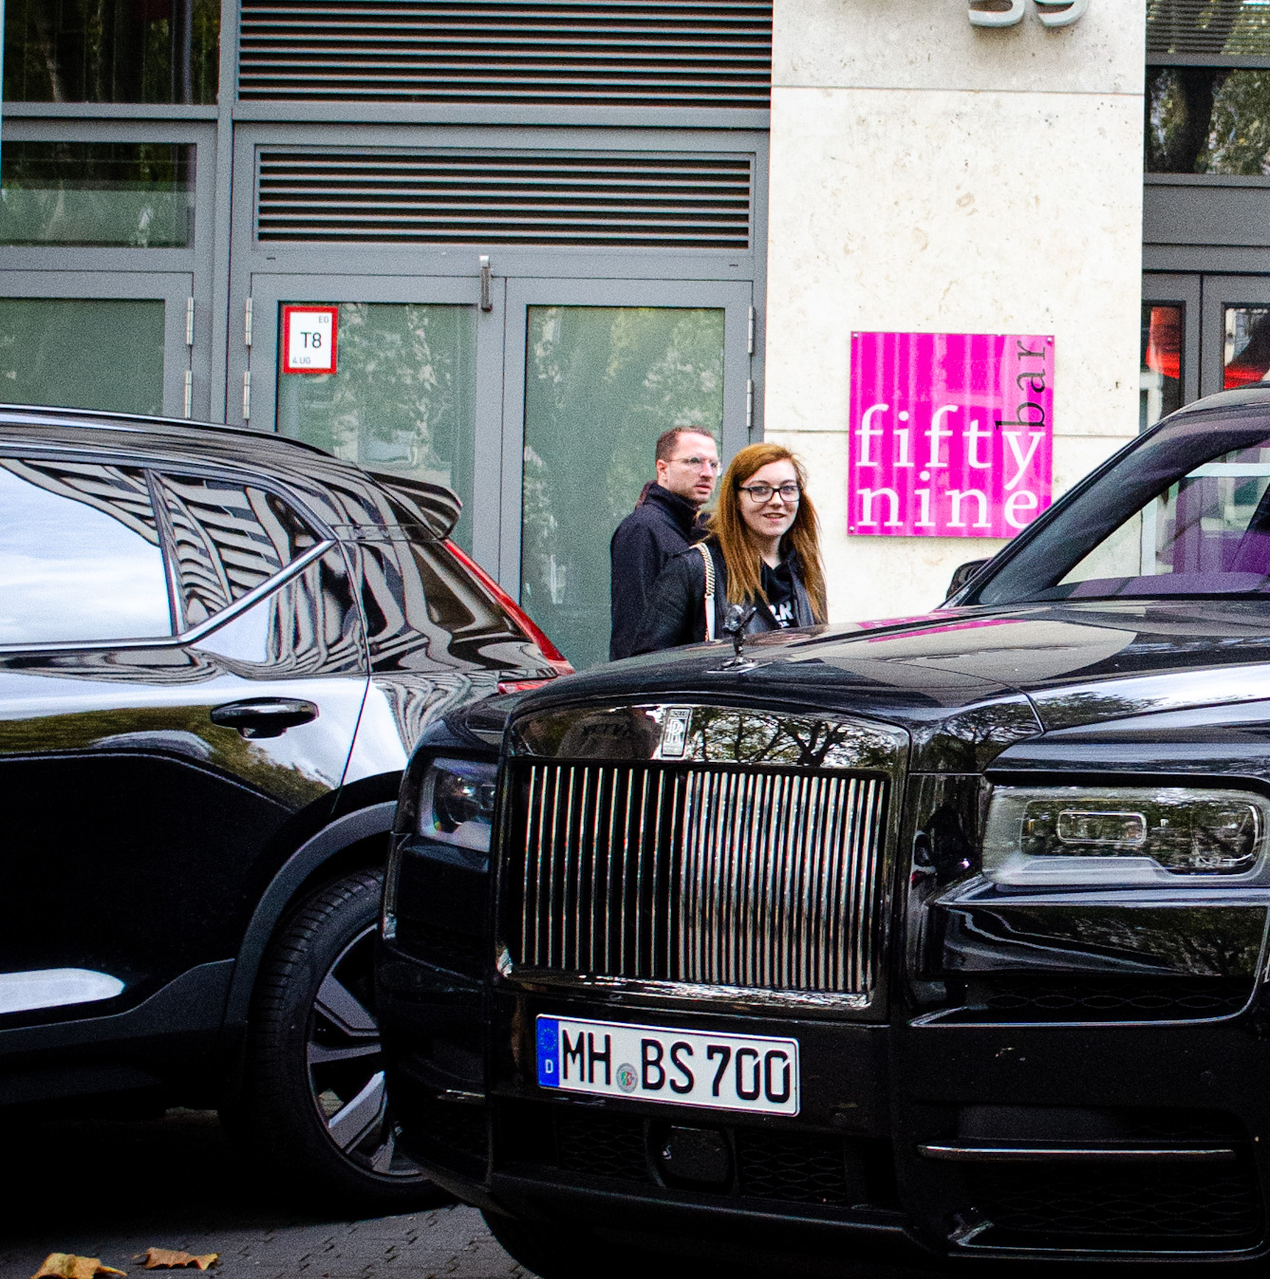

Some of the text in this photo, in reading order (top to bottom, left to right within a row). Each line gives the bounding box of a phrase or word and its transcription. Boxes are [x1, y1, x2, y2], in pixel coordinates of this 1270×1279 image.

[300, 332, 321, 348] T8
[994, 340, 1047, 431] bar
[854, 403, 1046, 491] fifty
[856, 471, 1039, 529] nine
[545, 1059, 554, 1074] D
[562, 1029, 612, 1086] MH
[641, 1038, 695, 1095] BS
[706, 1044, 791, 1104] 700
